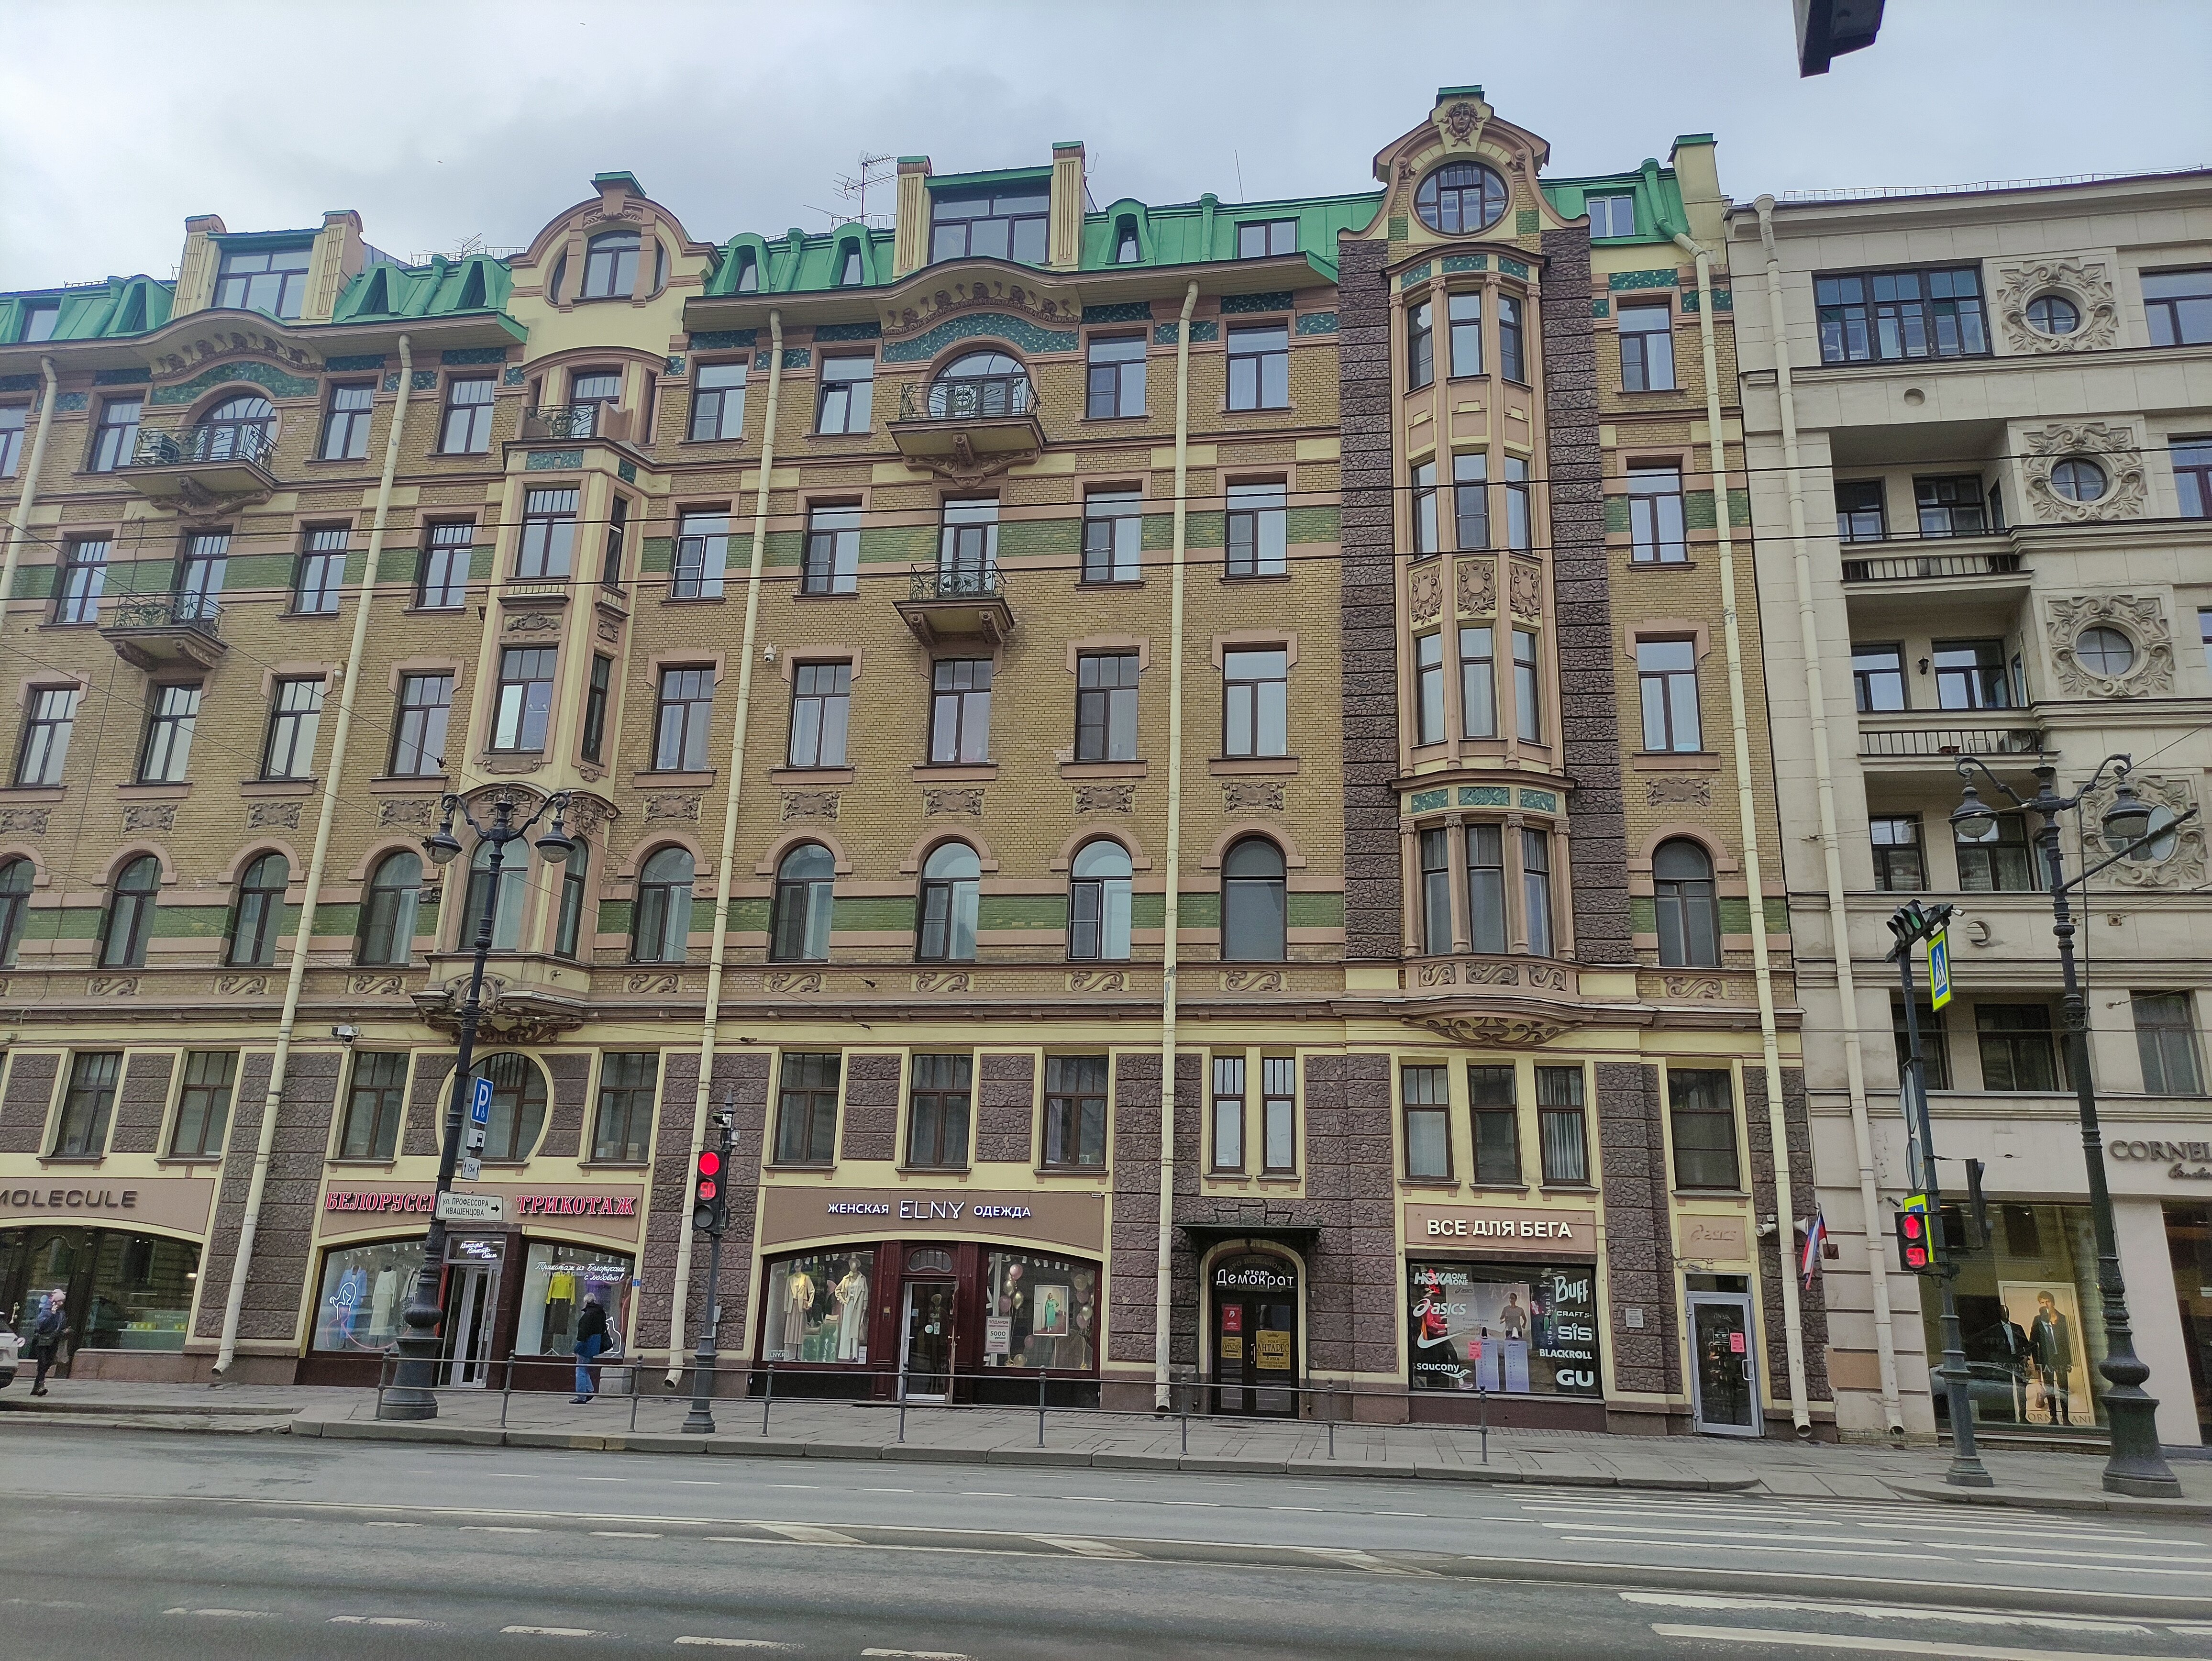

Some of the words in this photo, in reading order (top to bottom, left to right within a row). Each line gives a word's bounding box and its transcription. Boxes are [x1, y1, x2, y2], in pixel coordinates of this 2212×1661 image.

[325, 1192, 435, 1211] БЕЛОРУСС
[516, 1195, 636, 1215] ТРИКОТАЖ
[452, 1198, 488, 1207] ПРОФЕССОРА
[445, 1207, 484, 1217] ИВАШЕНЦОВА
[828, 1203, 889, 1214] ЖЕНСКАЯ
[899, 1200, 965, 1219] ELNY
[973, 1206, 1031, 1218] ОДЕЖДА
[1427, 1219, 1468, 1236] ВСЕ
[1472, 1220, 1515, 1237] ДЛЯ
[1520, 1220, 1573, 1238] БЕГА
[535, 1262, 575, 1272] Трикотаж
[586, 1263, 625, 1273] Белоруссии
[590, 1273, 624, 1281] любовью!
[1216, 1269, 1294, 1289] Демократ
[1414, 1273, 1453, 1285] HOKA
[1430, 1302, 1467, 1315] asics
[1257, 1343, 1289, 1353] АНТАРЕС
[1539, 1348, 1593, 1359] BLACKROLL
[1416, 1363, 1460, 1373] saucony
[1556, 1369, 1594, 1386] GU
[2028, 1413, 2091, 1424] ORNANI
